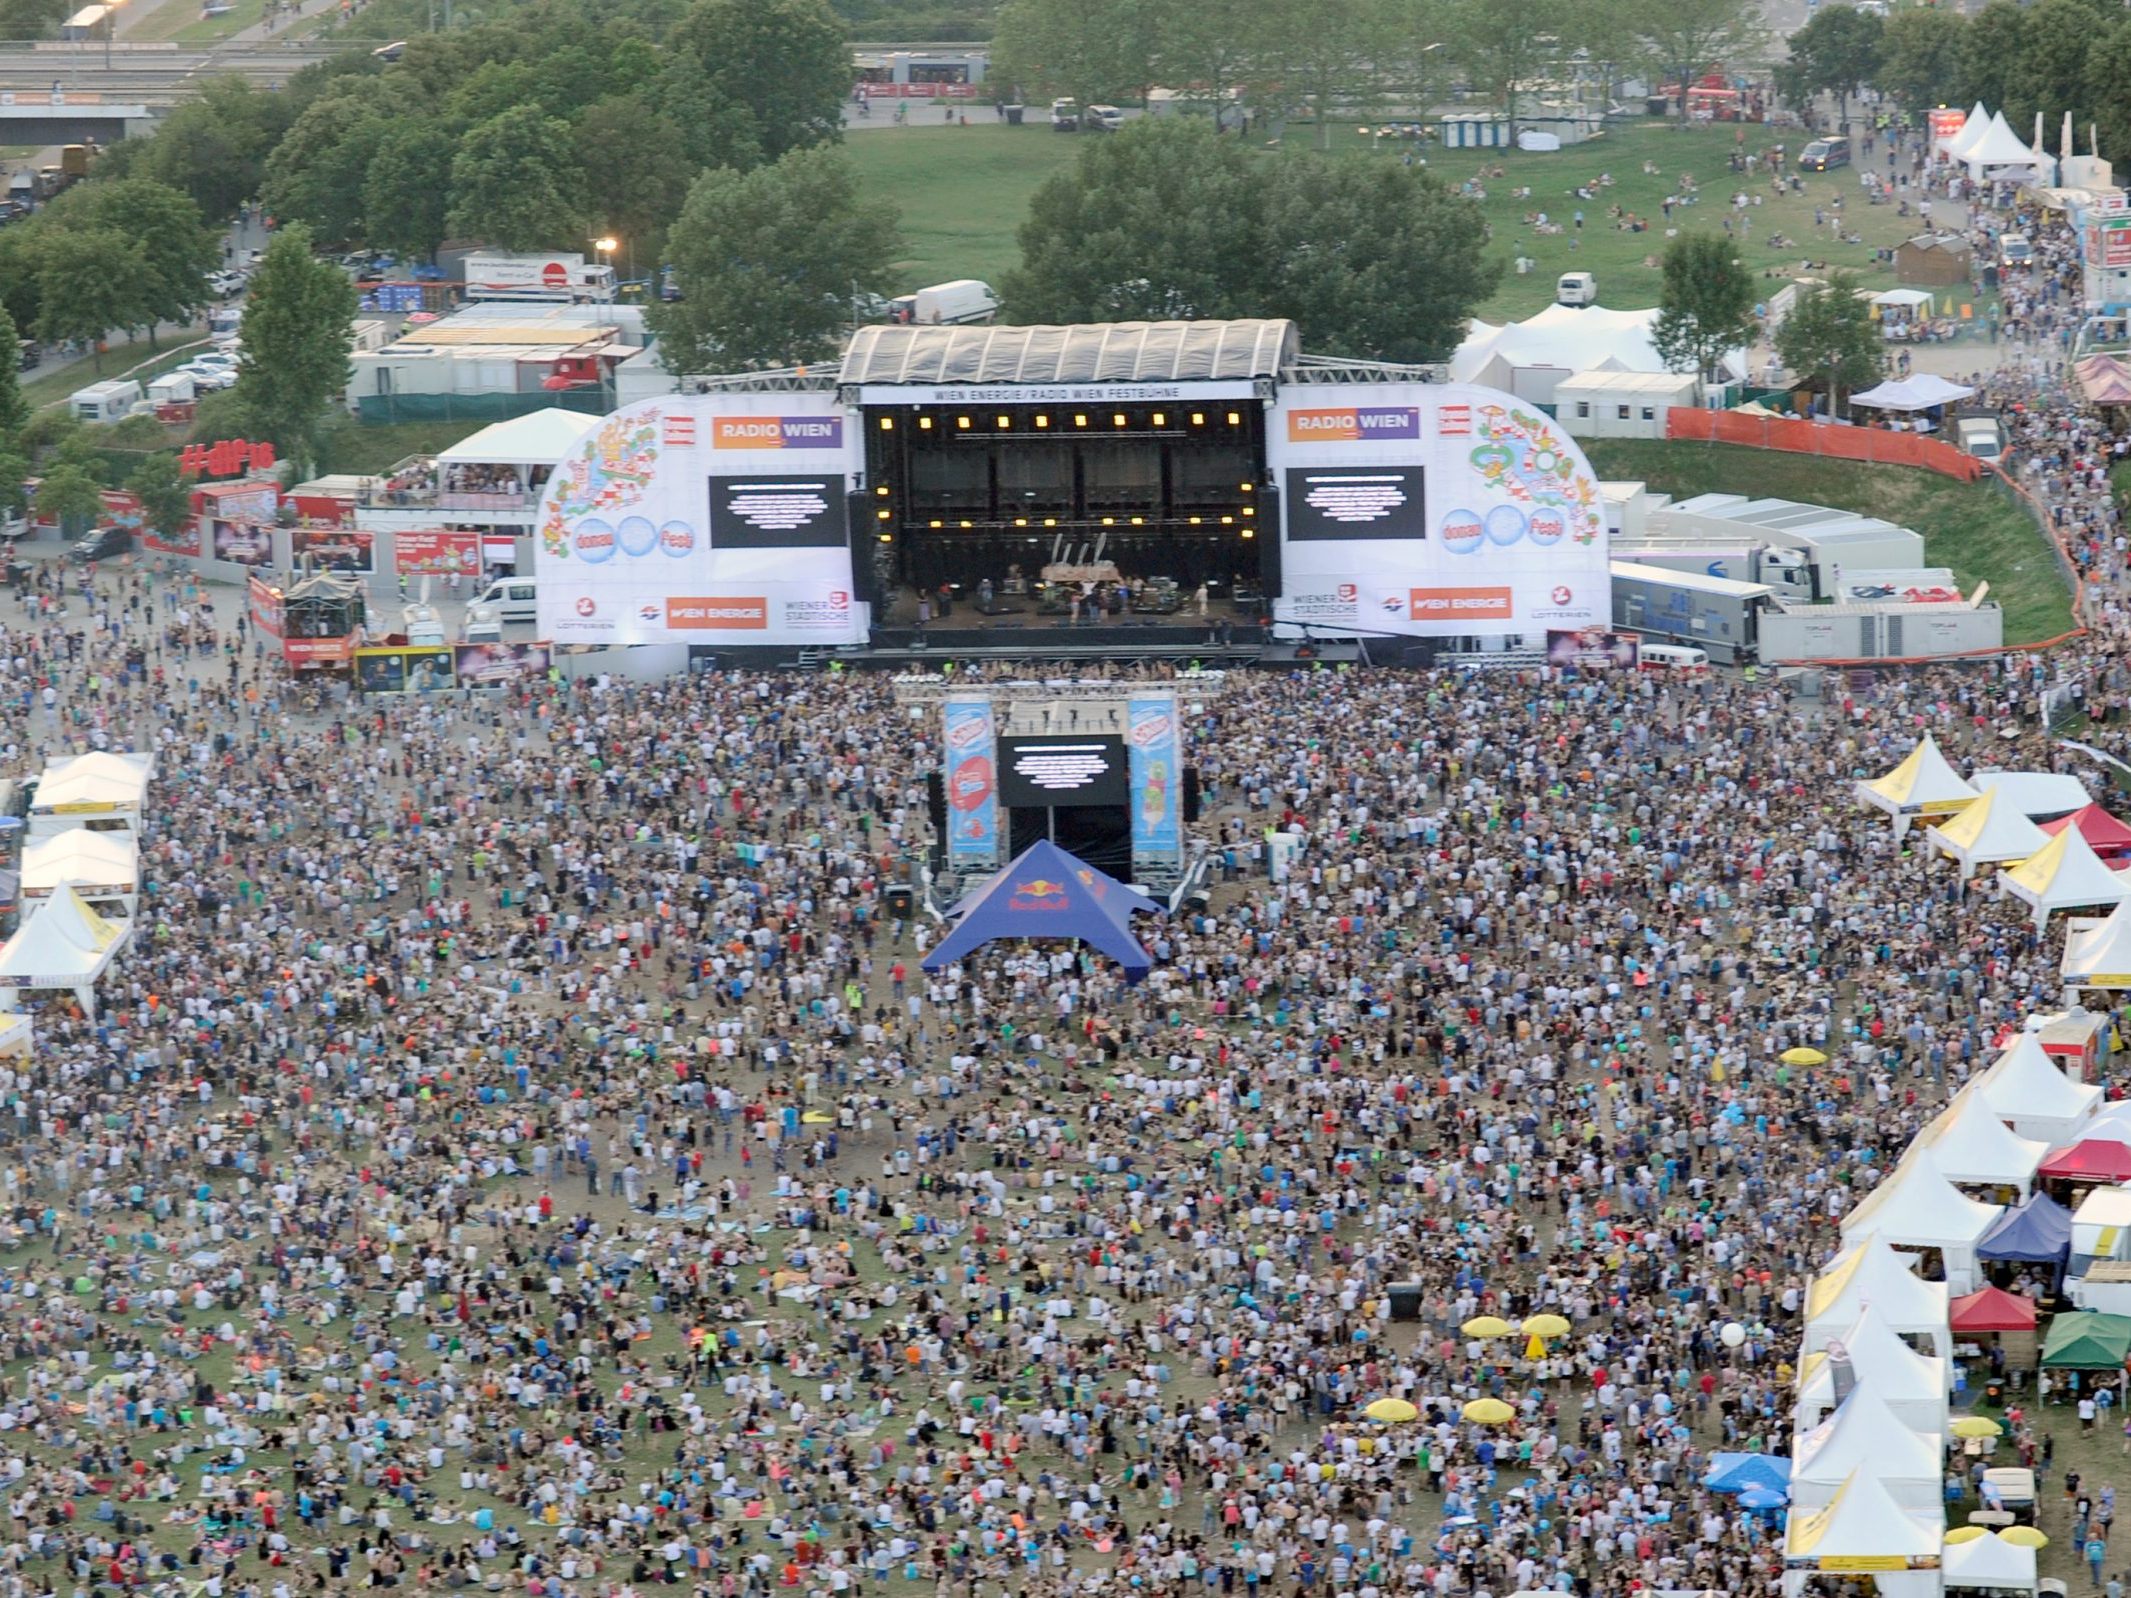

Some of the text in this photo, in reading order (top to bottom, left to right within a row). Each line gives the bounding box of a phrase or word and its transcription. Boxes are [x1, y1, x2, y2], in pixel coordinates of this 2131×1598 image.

[935, 390, 965, 400] WIEN
[1073, 389, 1102, 399] WIEN
[1297, 415, 1408, 429] RADIO WIEN
[722, 423, 832, 437] RADIO WIEN
[1293, 594, 1336, 604] WIENER
[1414, 598, 1507, 609] WIEN ENERGIE
[785, 601, 828, 610] WIENER
[671, 608, 762, 618] WIEN ENERGIE
